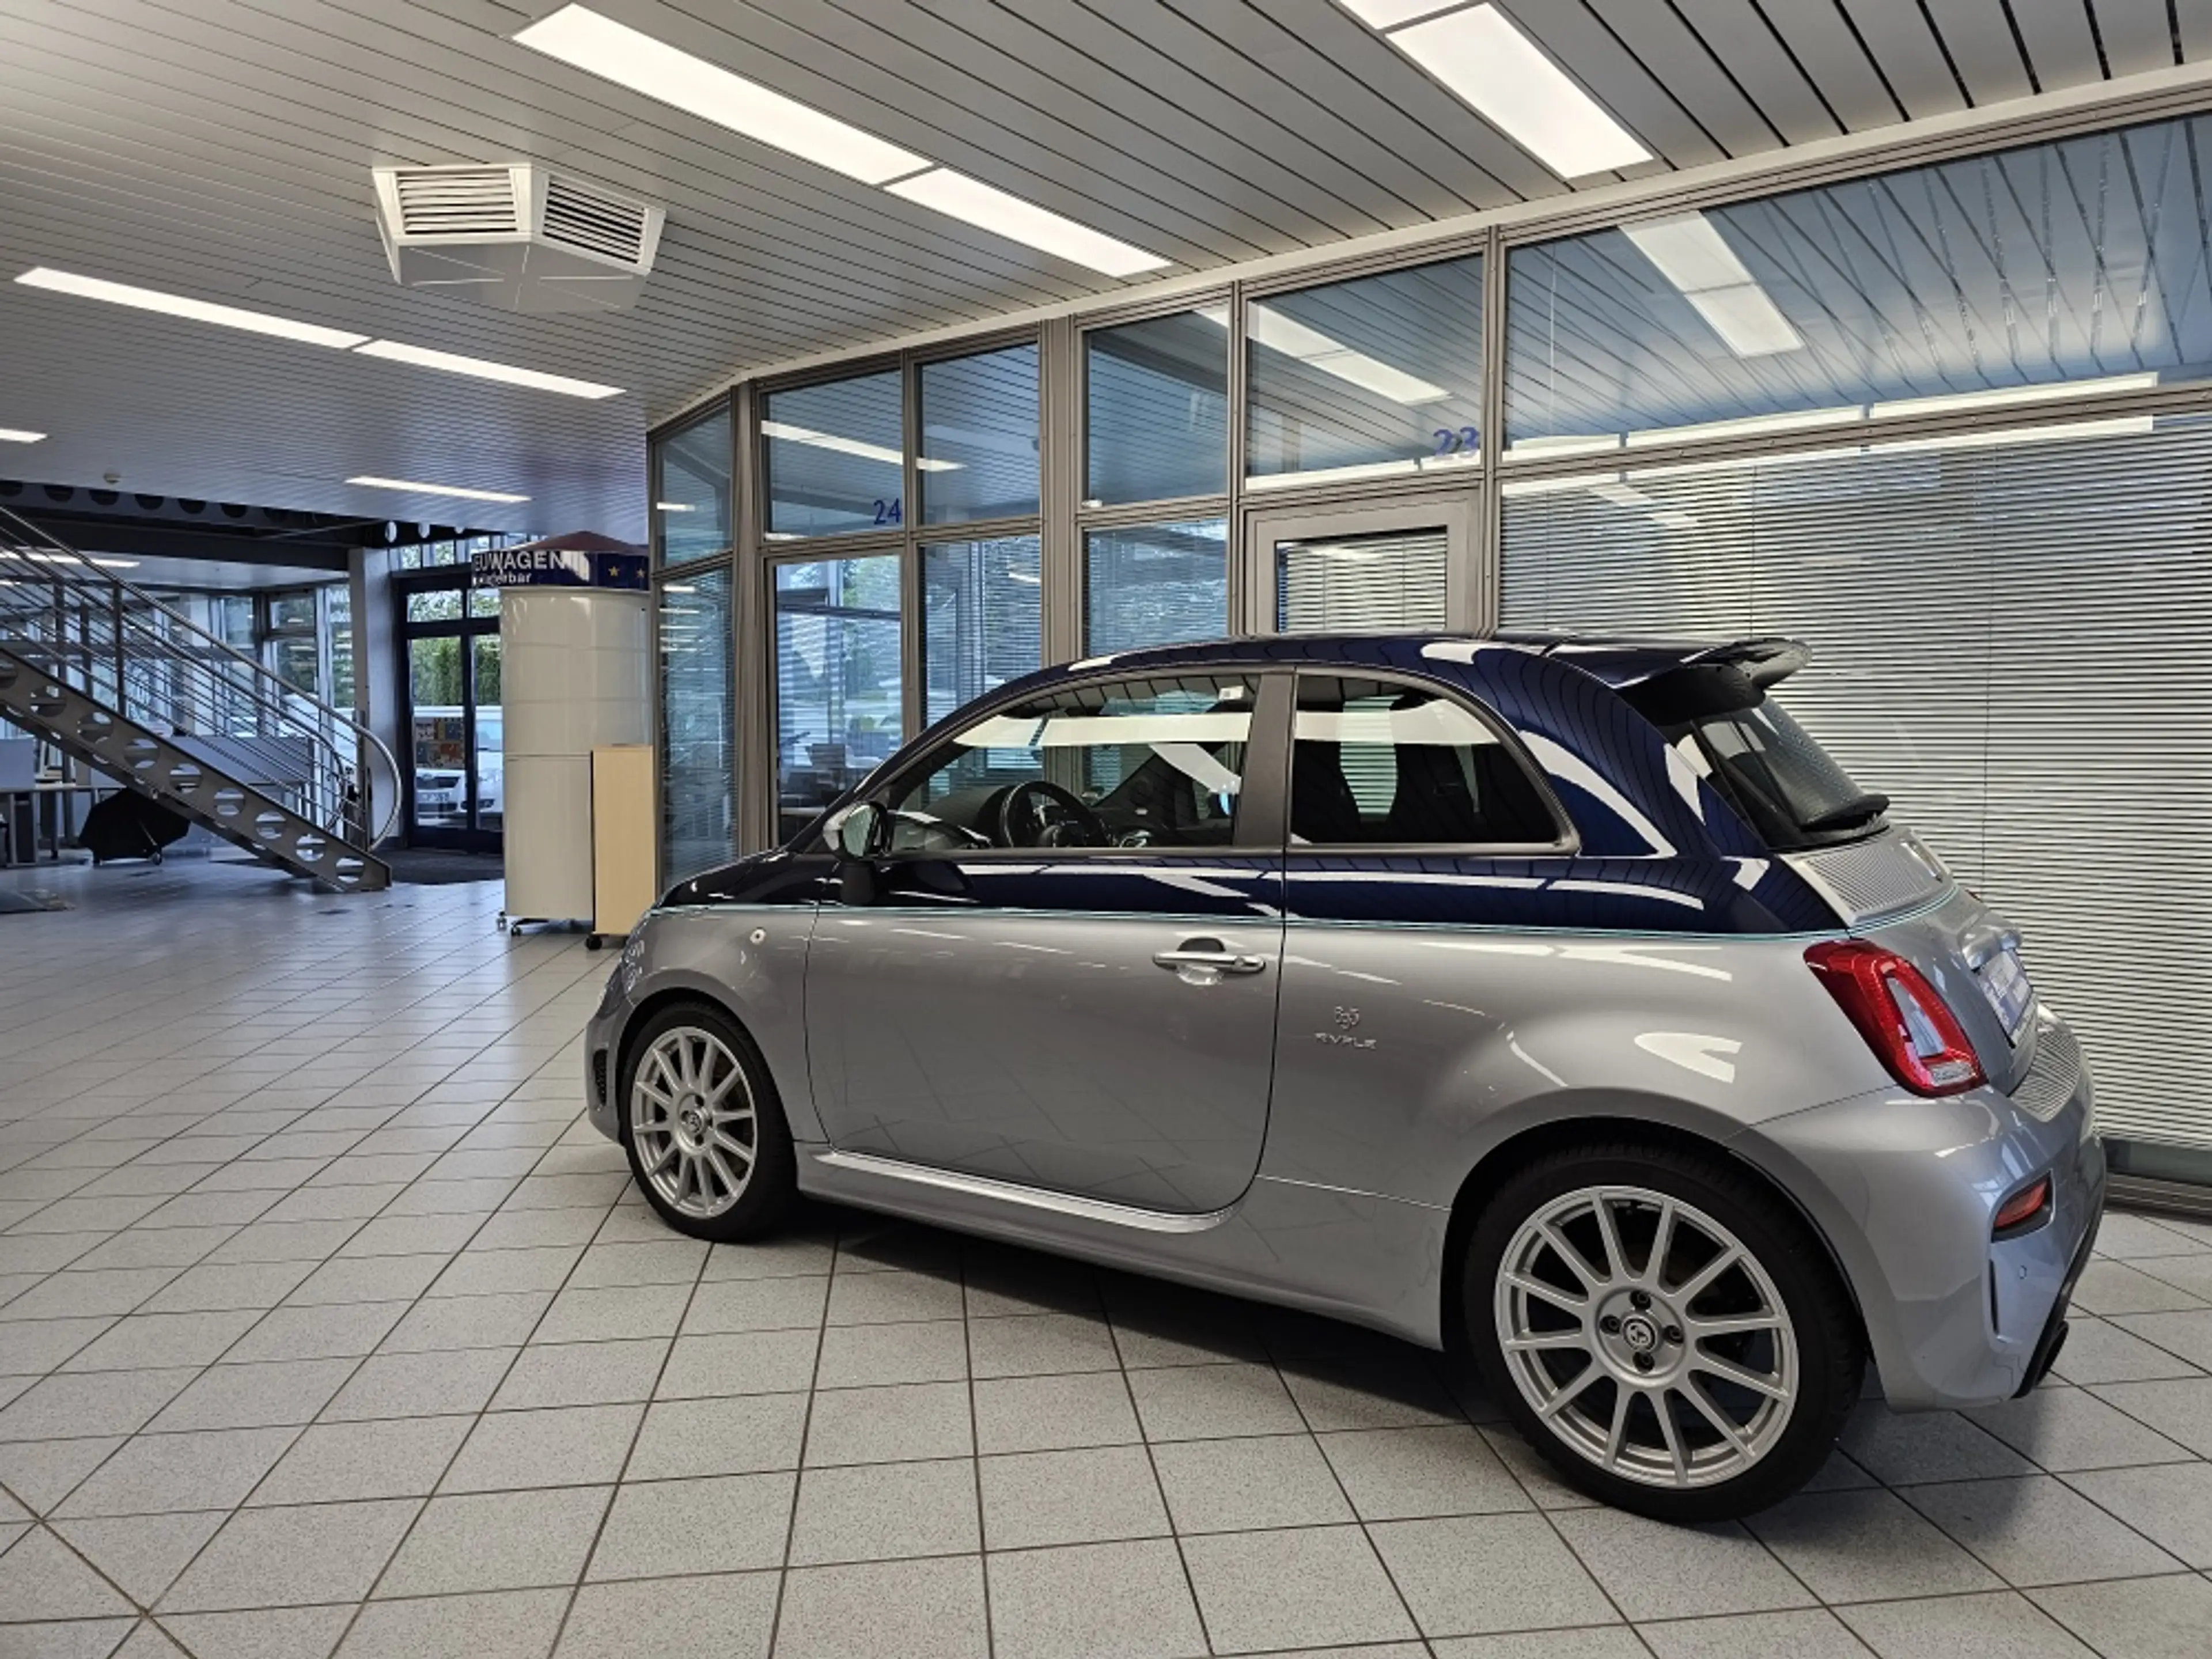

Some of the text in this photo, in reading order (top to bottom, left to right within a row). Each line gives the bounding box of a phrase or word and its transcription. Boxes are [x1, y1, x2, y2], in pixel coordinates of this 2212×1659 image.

[1433, 426, 1479, 459] 23
[873, 497, 902, 525] 24
[1314, 1032, 1377, 1050] RVALE
